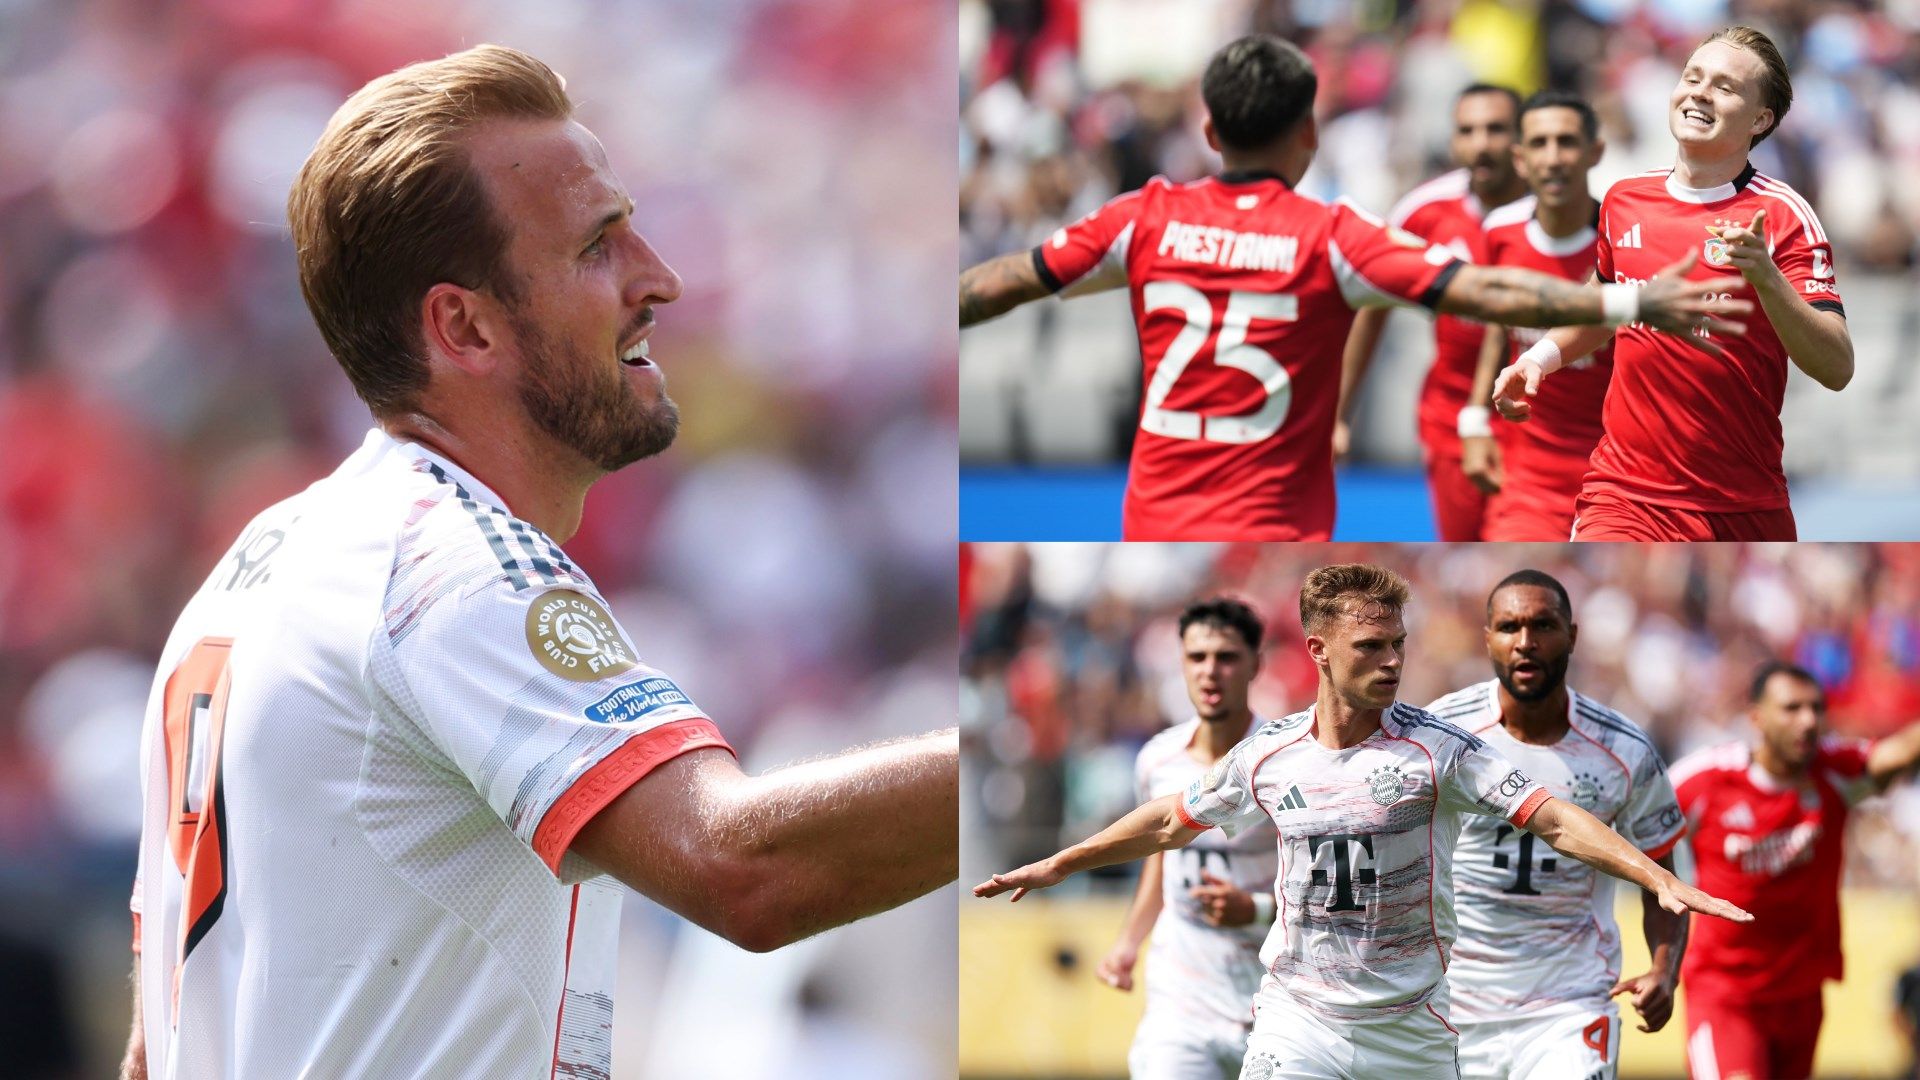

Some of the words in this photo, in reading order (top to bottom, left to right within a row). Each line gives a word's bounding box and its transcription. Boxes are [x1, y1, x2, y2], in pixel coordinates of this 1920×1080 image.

[1157, 219, 1299, 274] PRESTIANNI
[1141, 280, 1298, 444] 25
[538, 599, 567, 636] WORLD
[571, 600, 597, 618] CUP
[543, 640, 578, 668] CLUB
[596, 685, 645, 716] FOOTBALL
[605, 712, 628, 723] the
[624, 693, 662, 716] World
[164, 636, 235, 1032] 9
